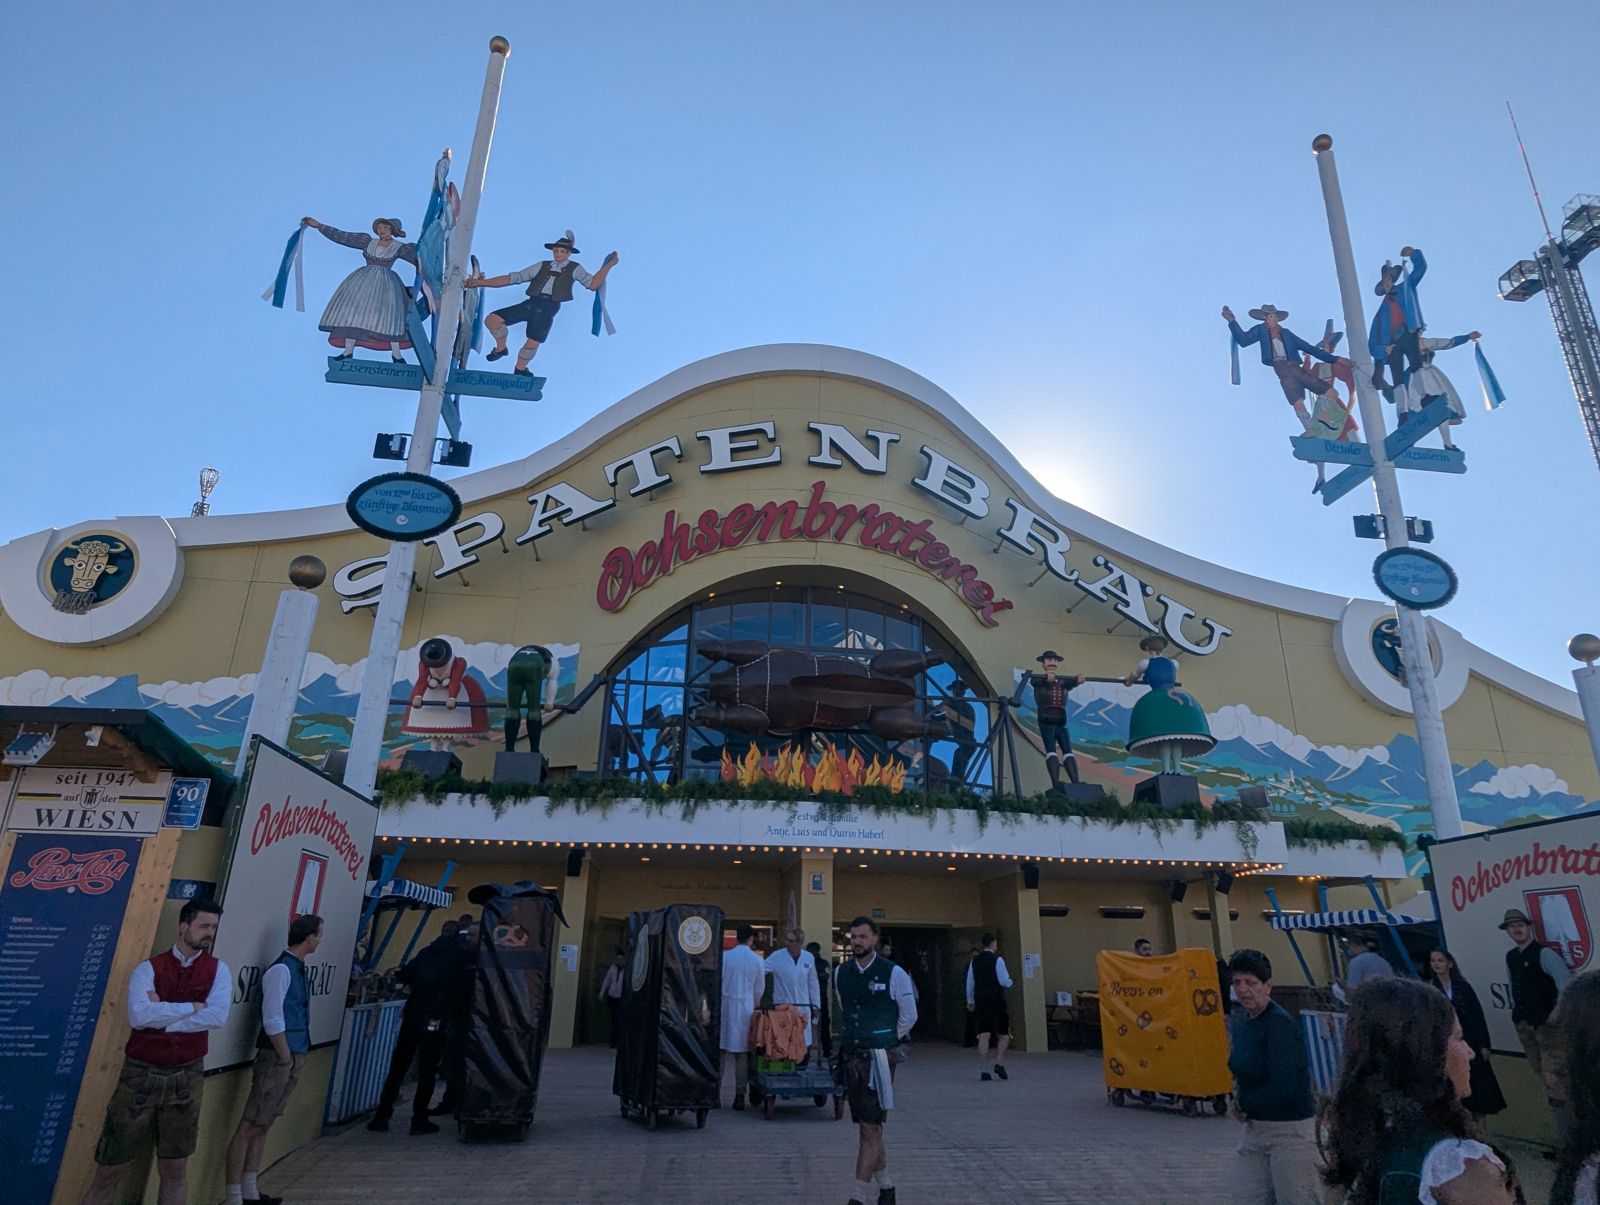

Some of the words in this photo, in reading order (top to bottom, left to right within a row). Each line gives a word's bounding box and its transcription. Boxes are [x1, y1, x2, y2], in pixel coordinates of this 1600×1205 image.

[56, 771, 88, 786] seit
[96, 772, 137, 787] 1947
[63, 793, 80, 803] auf
[102, 795, 118, 804] der
[176, 786, 200, 802] 90
[36, 808, 141, 831] WIESN
[251, 795, 364, 881] Ochsenbraterei
[812, 828, 828, 837] und
[233, 961, 337, 1005] SPRÄU
